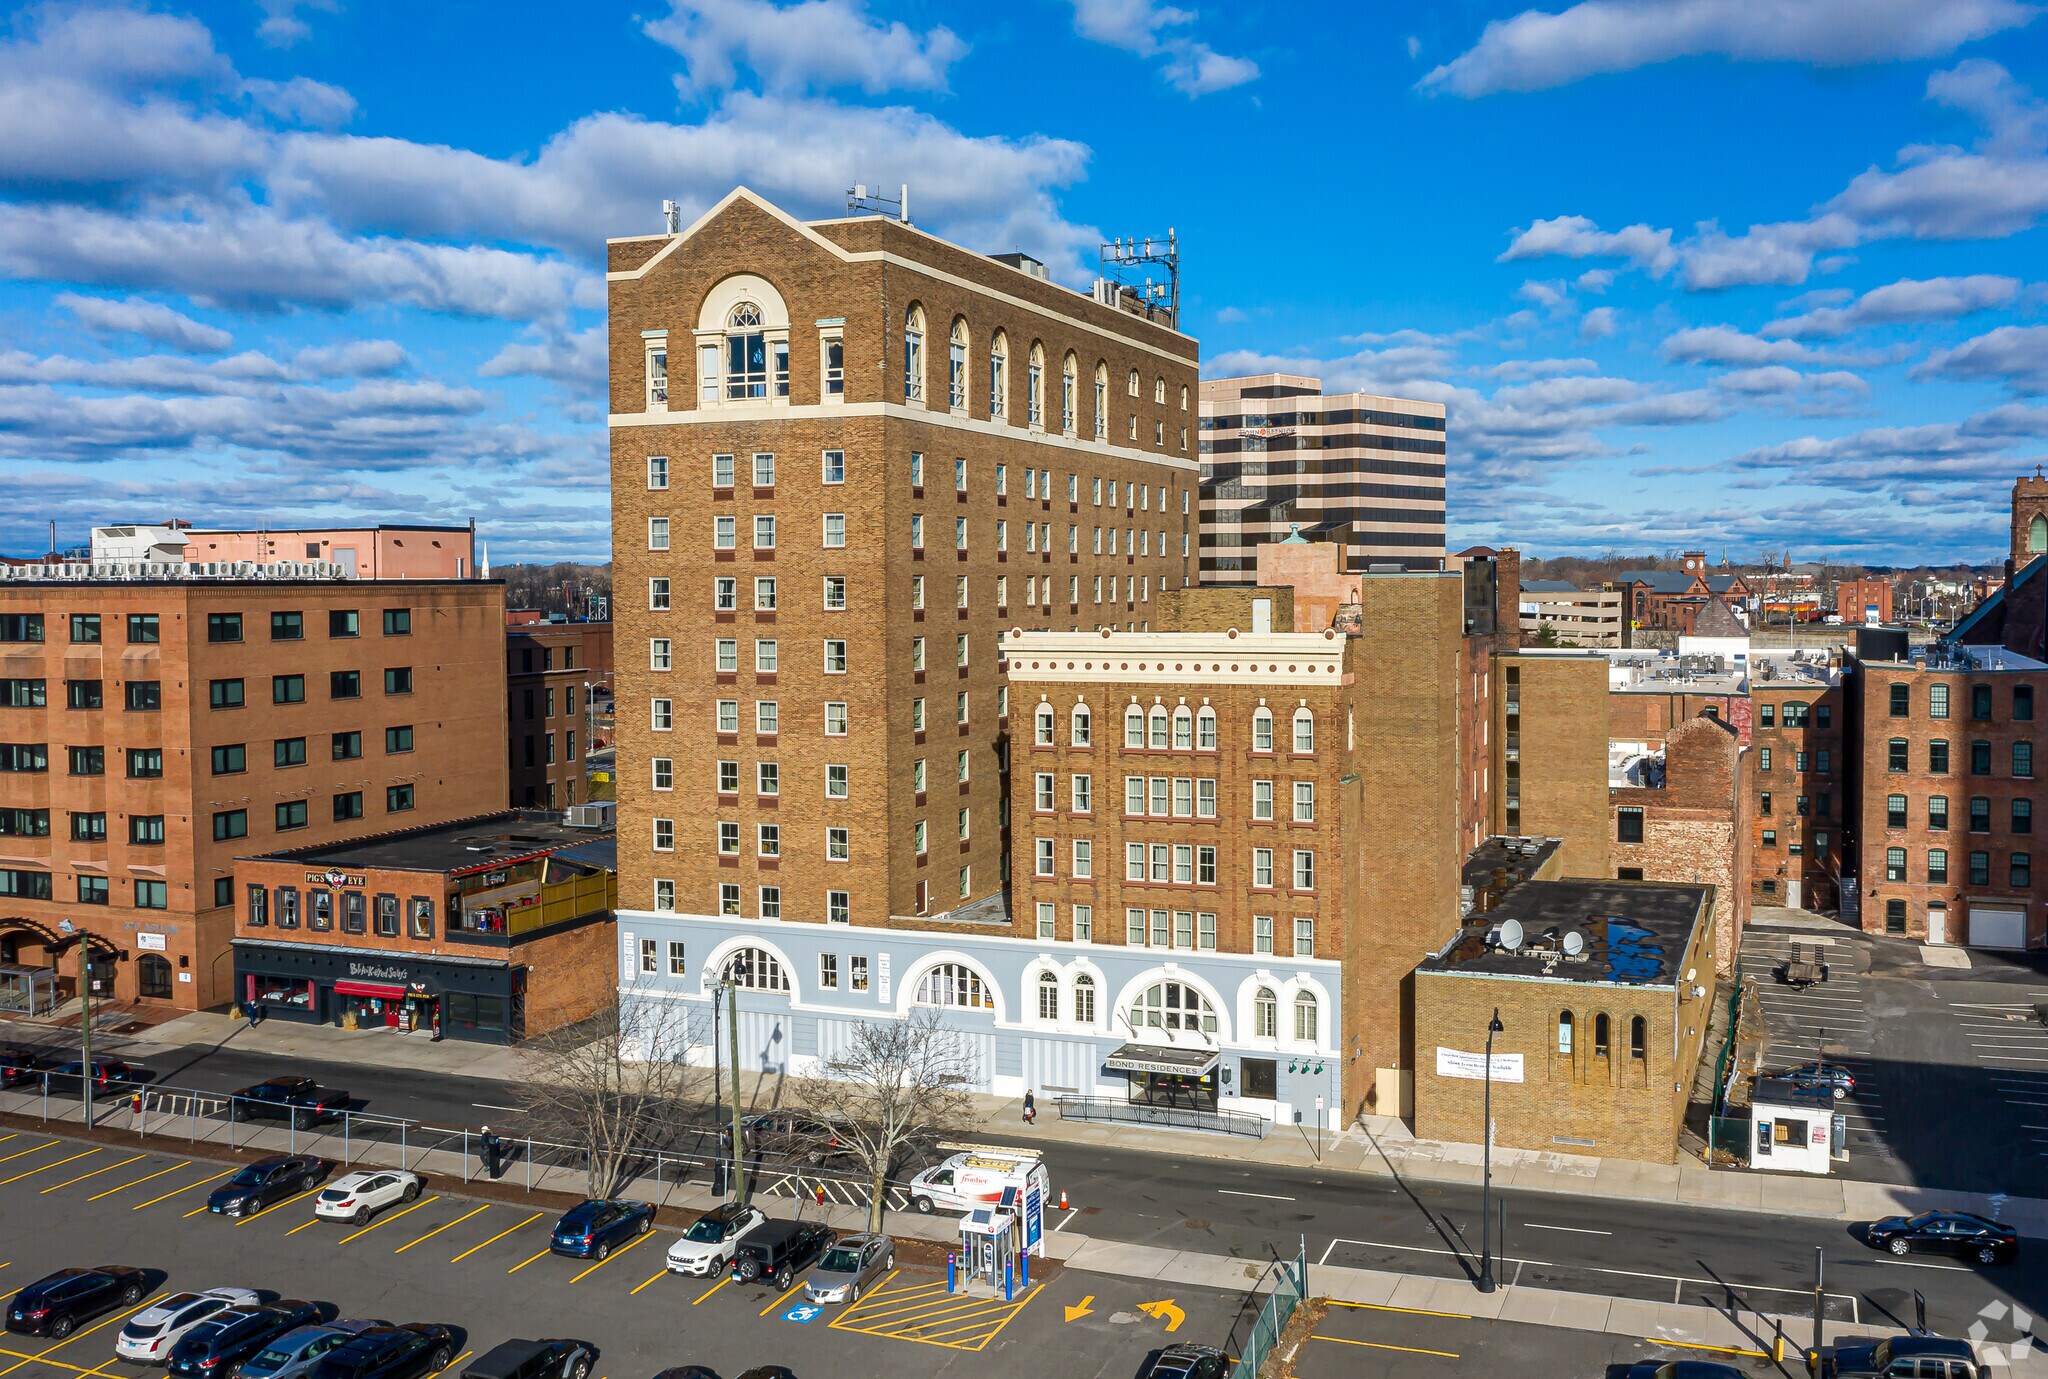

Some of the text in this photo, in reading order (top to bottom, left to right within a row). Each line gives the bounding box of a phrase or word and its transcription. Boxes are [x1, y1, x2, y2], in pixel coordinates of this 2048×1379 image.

[307, 873, 364, 886] PIG'S EYE
[1109, 1060, 1134, 1069] BOND
[1138, 1063, 1198, 1074] RESIDENCES
[960, 1173, 988, 1184] frontier
